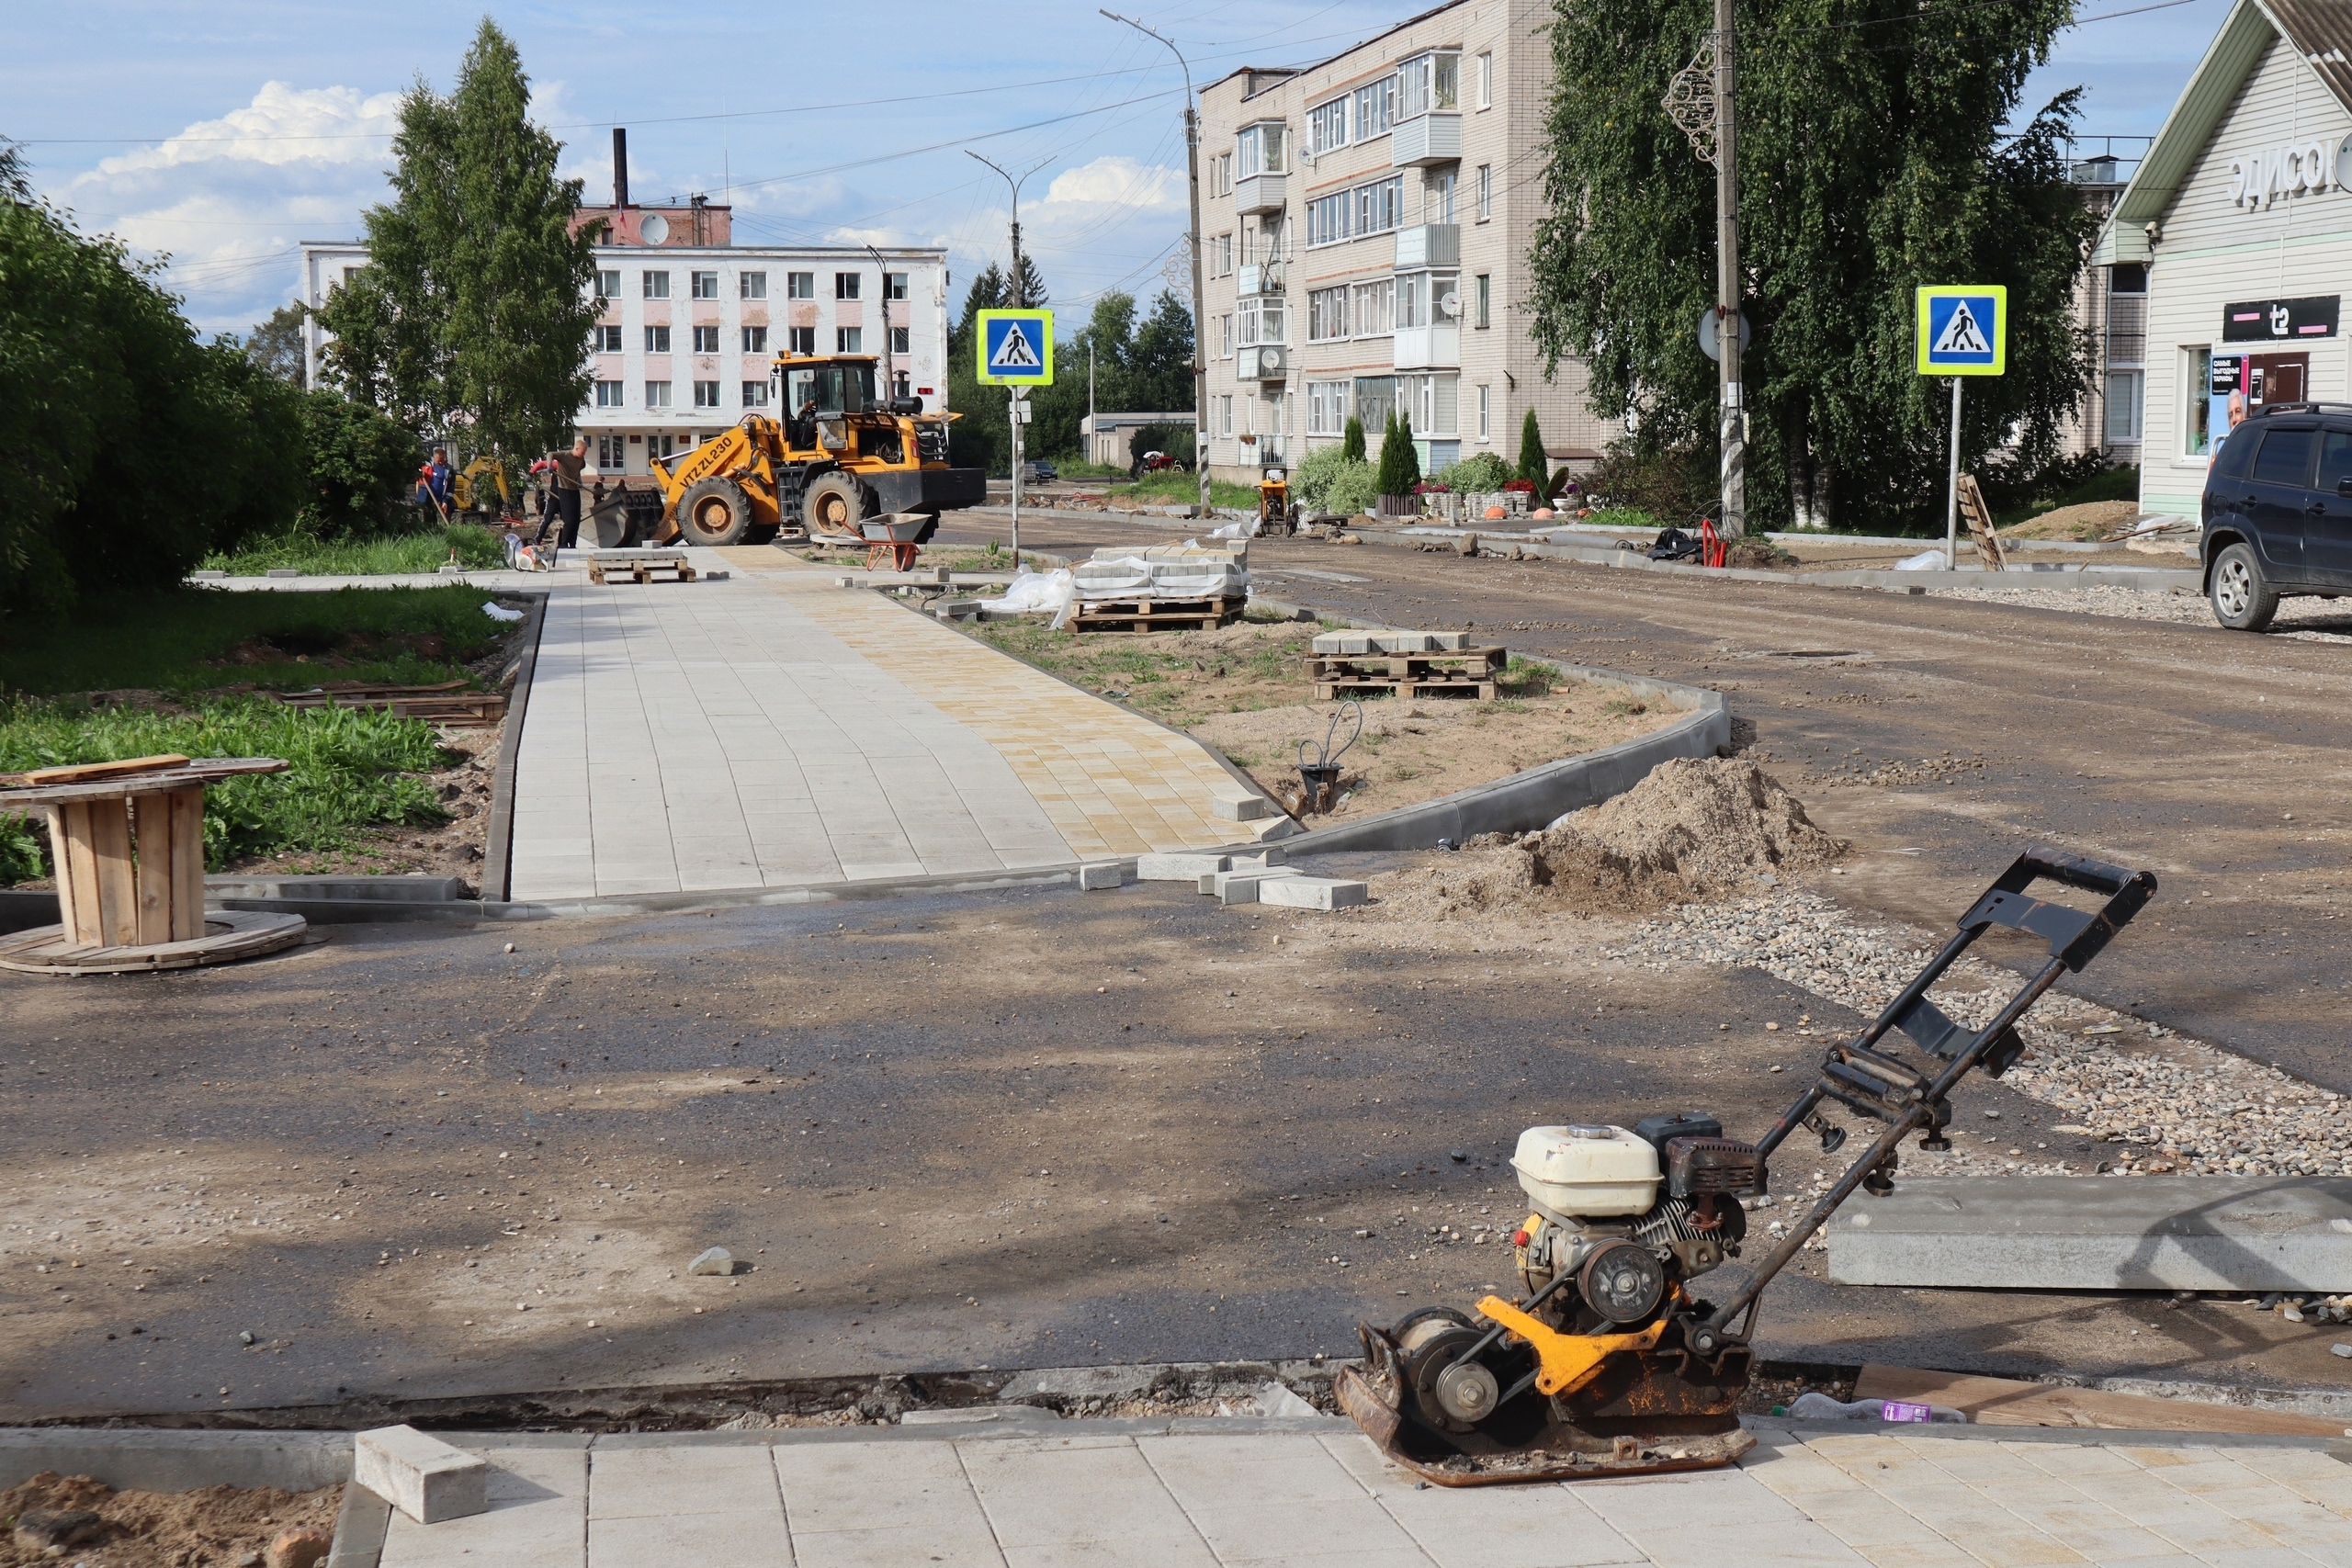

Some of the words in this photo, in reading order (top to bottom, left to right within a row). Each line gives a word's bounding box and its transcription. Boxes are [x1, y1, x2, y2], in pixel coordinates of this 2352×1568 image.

[2270, 304, 2290, 335] t2
[2213, 359, 2232, 367] САМЫЕ
[679, 466, 702, 488] VTZ
[697, 436, 732, 471] ZL230
